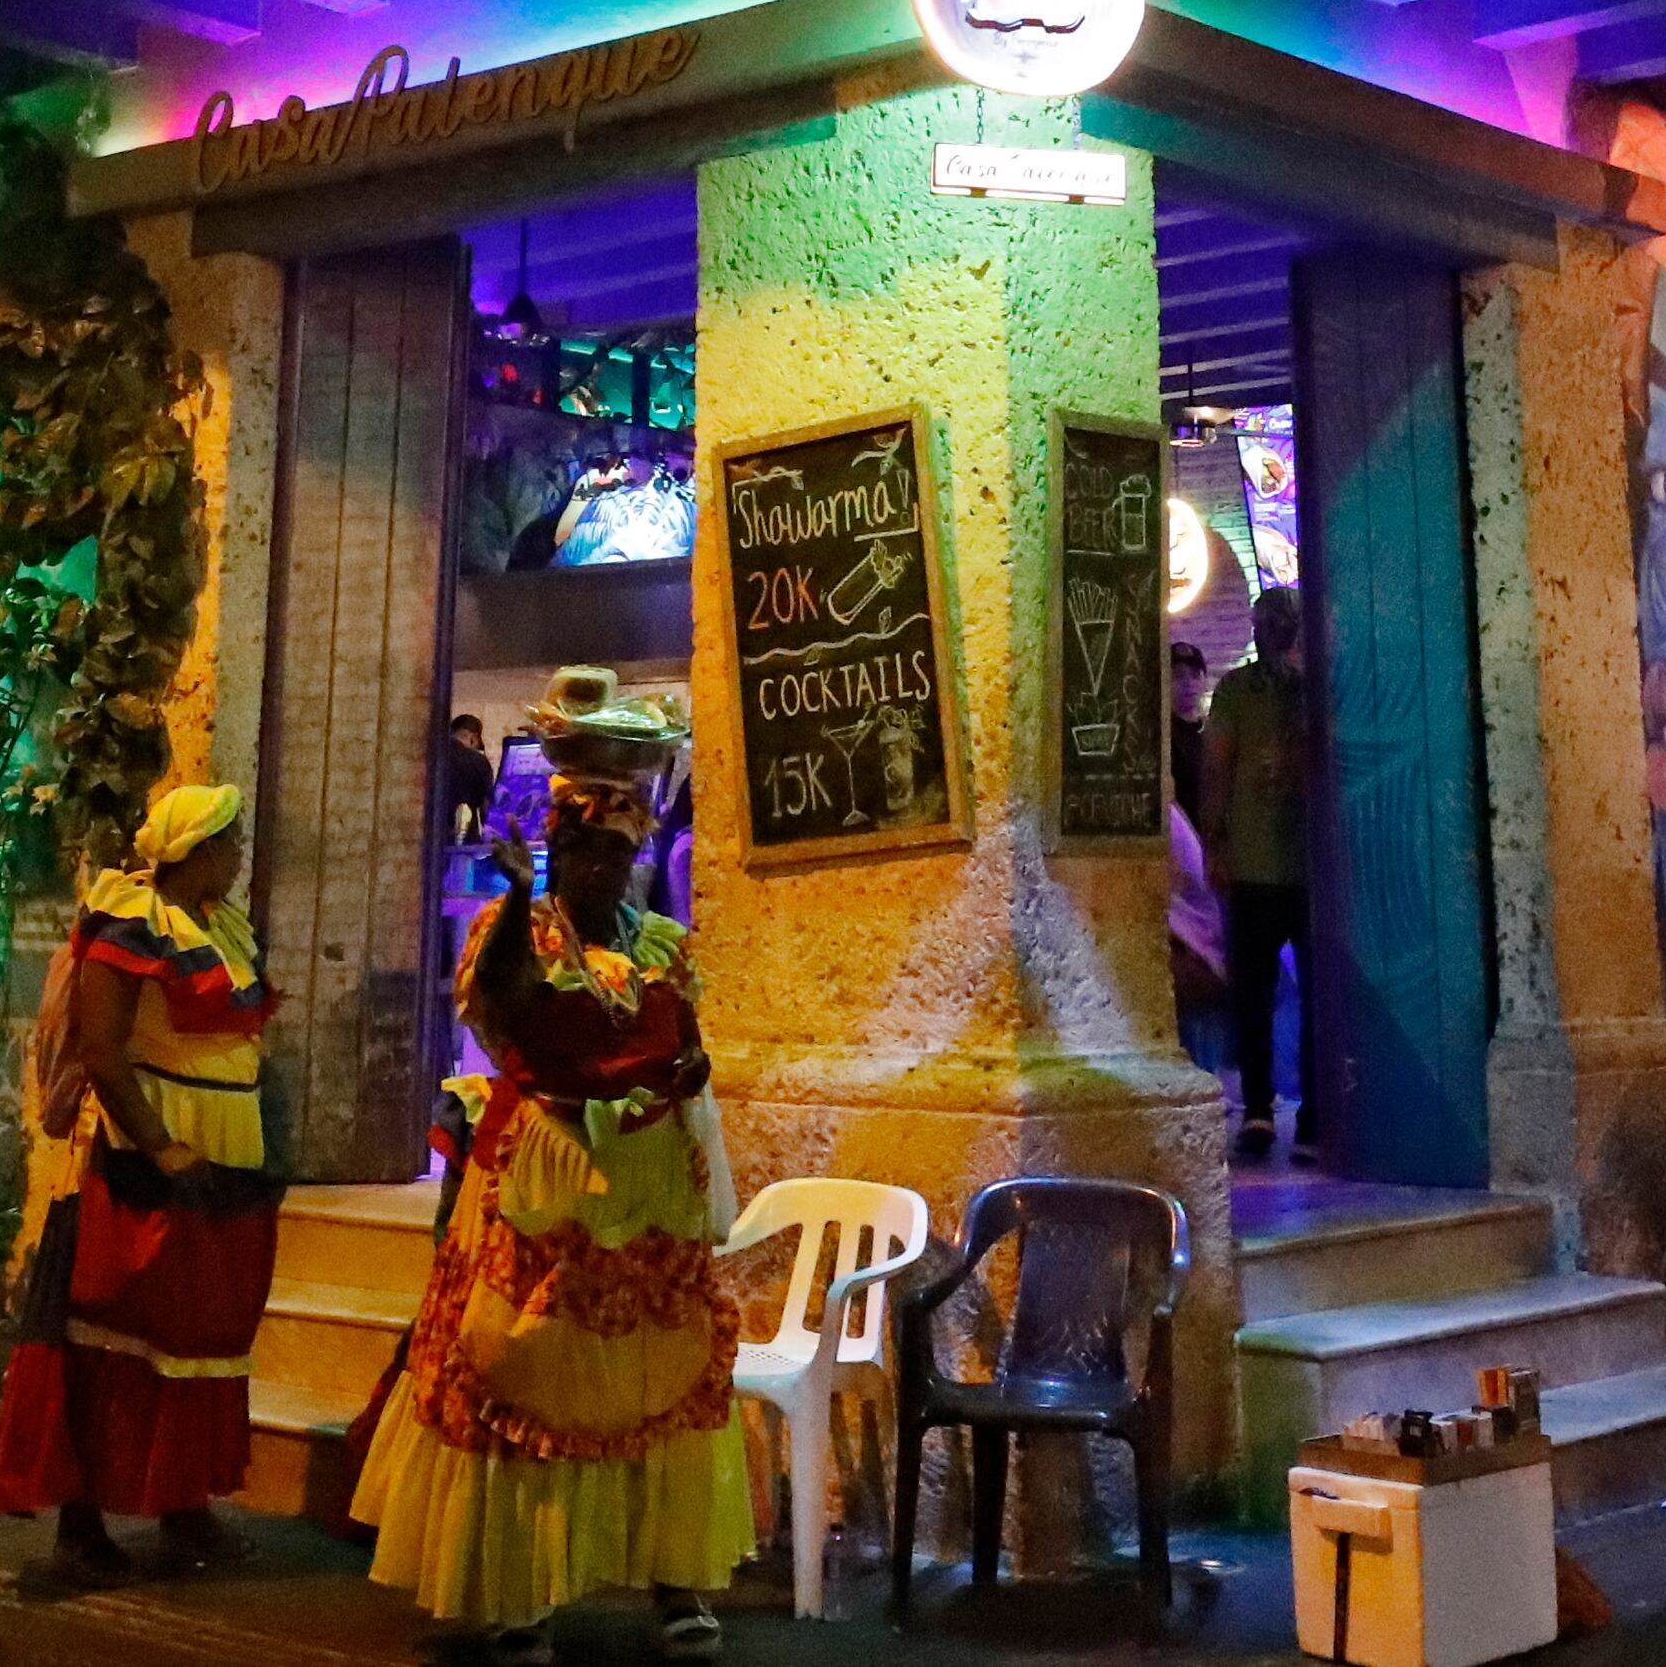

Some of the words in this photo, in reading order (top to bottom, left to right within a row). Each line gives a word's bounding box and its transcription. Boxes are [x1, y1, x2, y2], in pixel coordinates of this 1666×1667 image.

[195, 91, 339, 195] Casa
[1064, 461, 1115, 500] COLD
[1068, 502, 1119, 549] BEER
[747, 564, 819, 630] 20K
[759, 649, 931, 721] COCKTAILS
[764, 752, 832, 818] 15K
